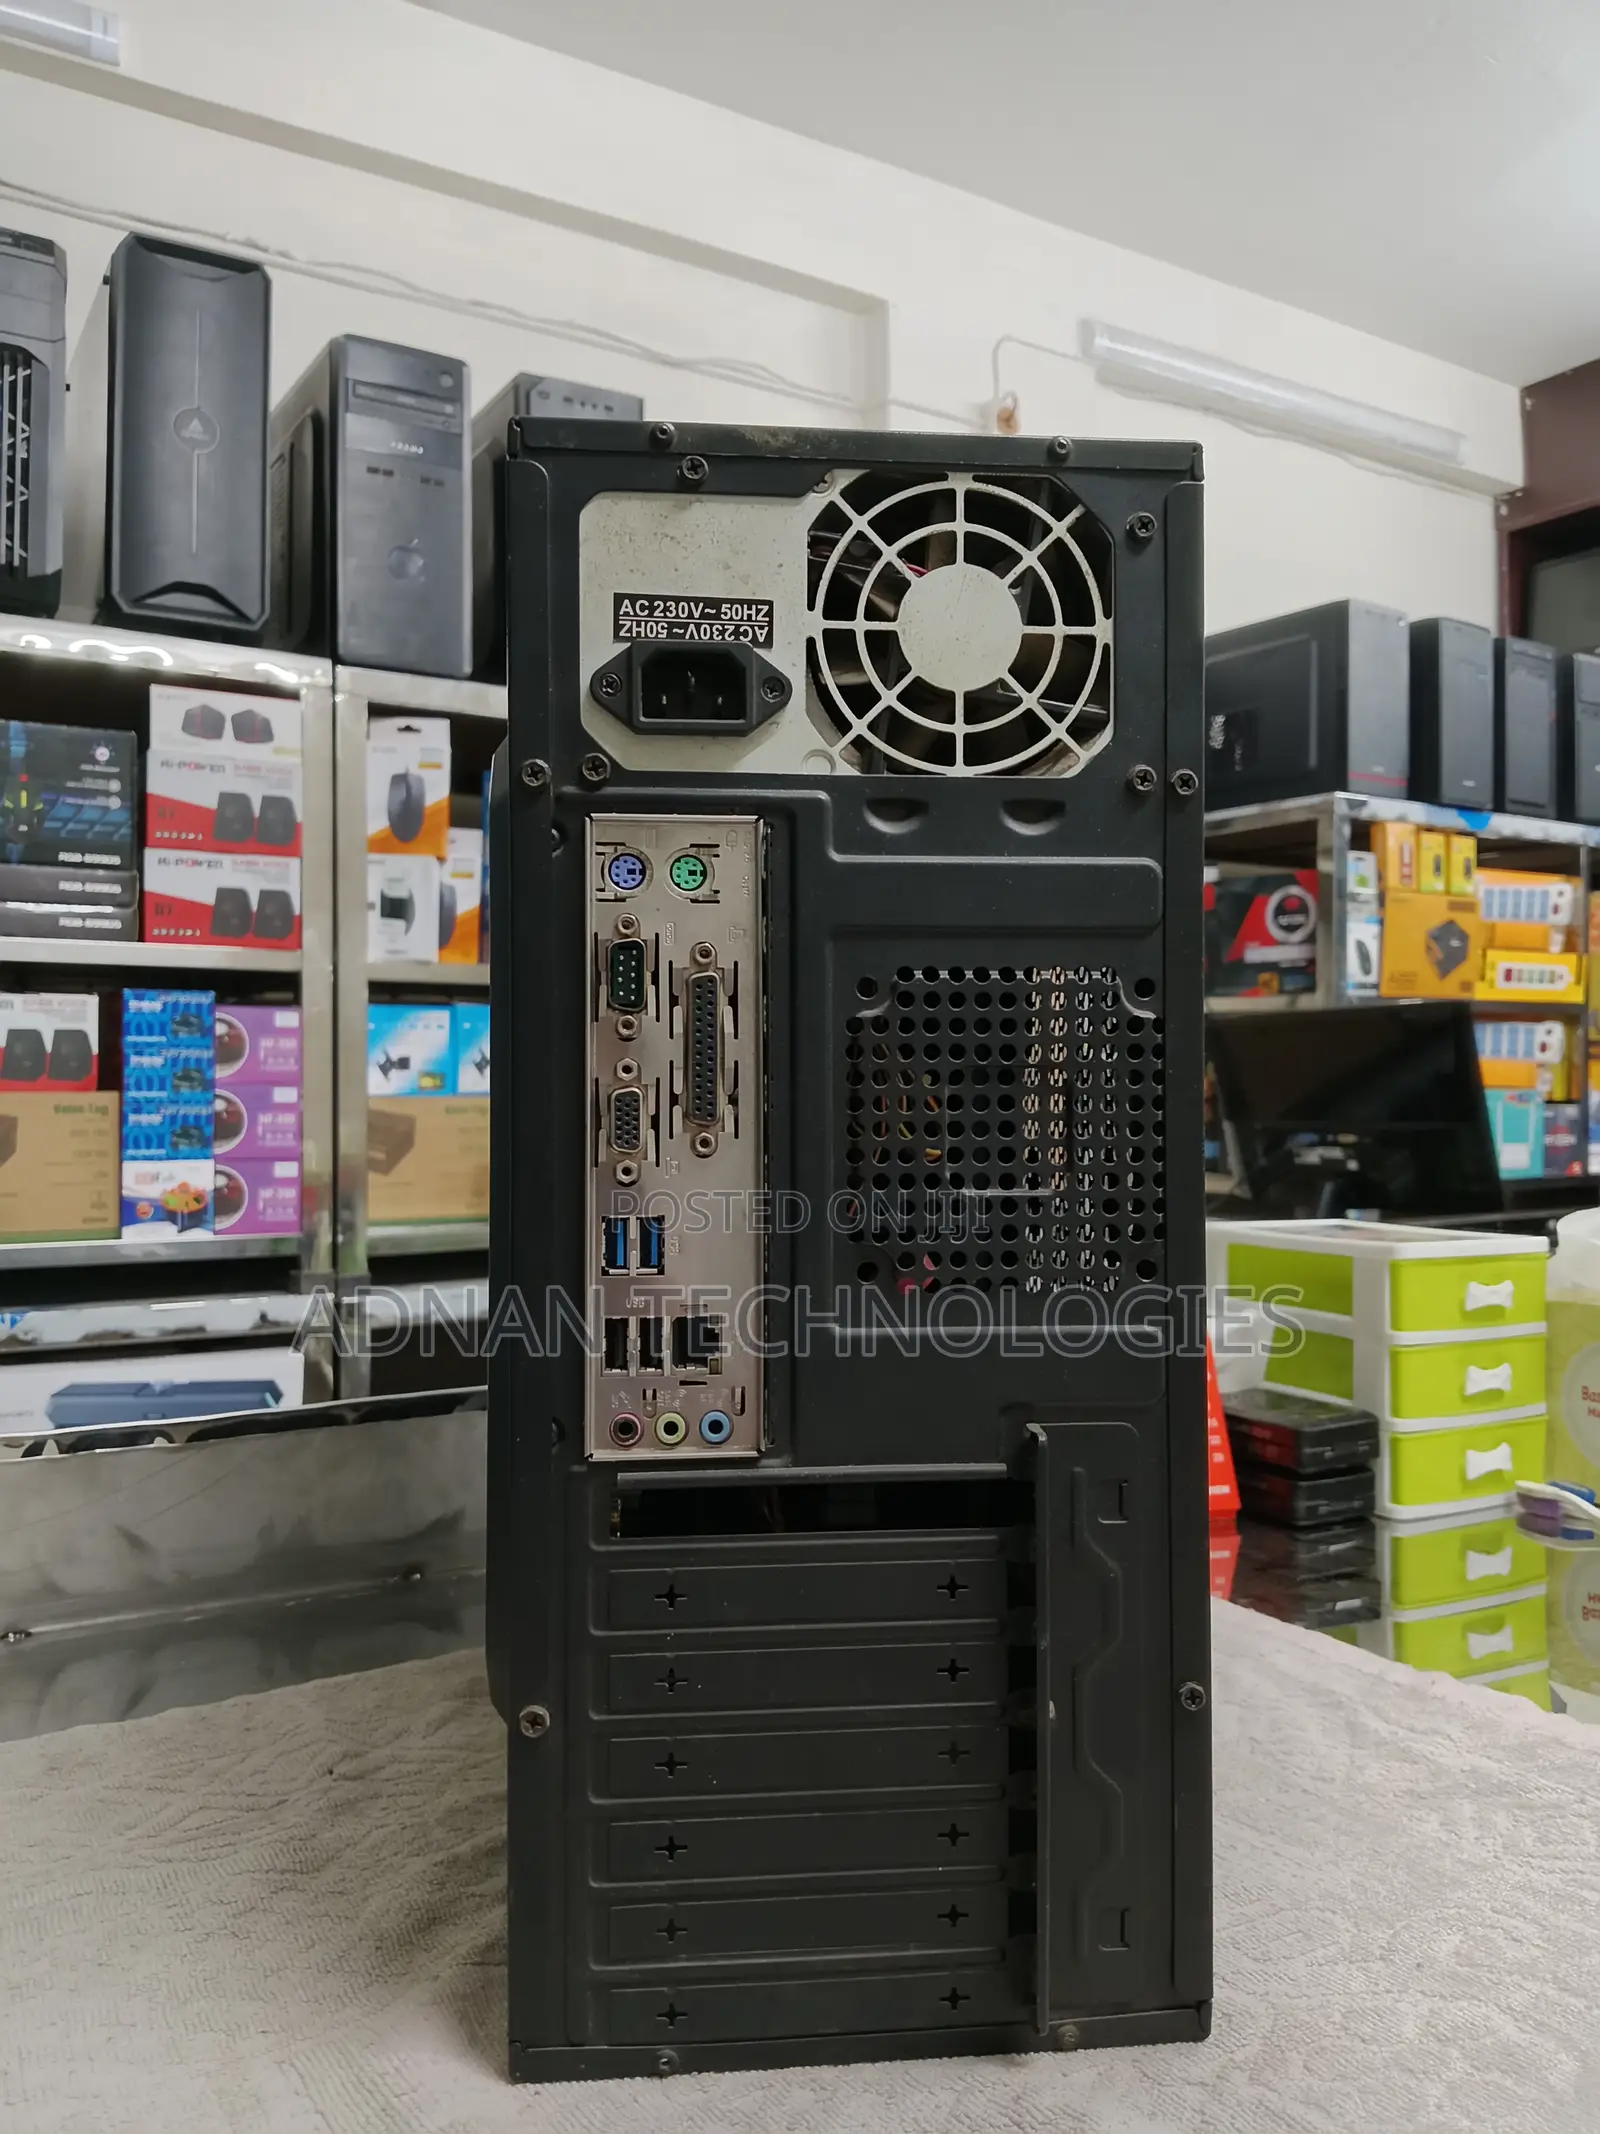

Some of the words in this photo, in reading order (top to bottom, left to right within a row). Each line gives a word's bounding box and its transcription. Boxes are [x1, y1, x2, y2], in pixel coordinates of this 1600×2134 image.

[619, 599, 649, 616] AC
[720, 603, 770, 621] 50HZ
[618, 620, 668, 638] 50HZ
[739, 625, 769, 643] AC
